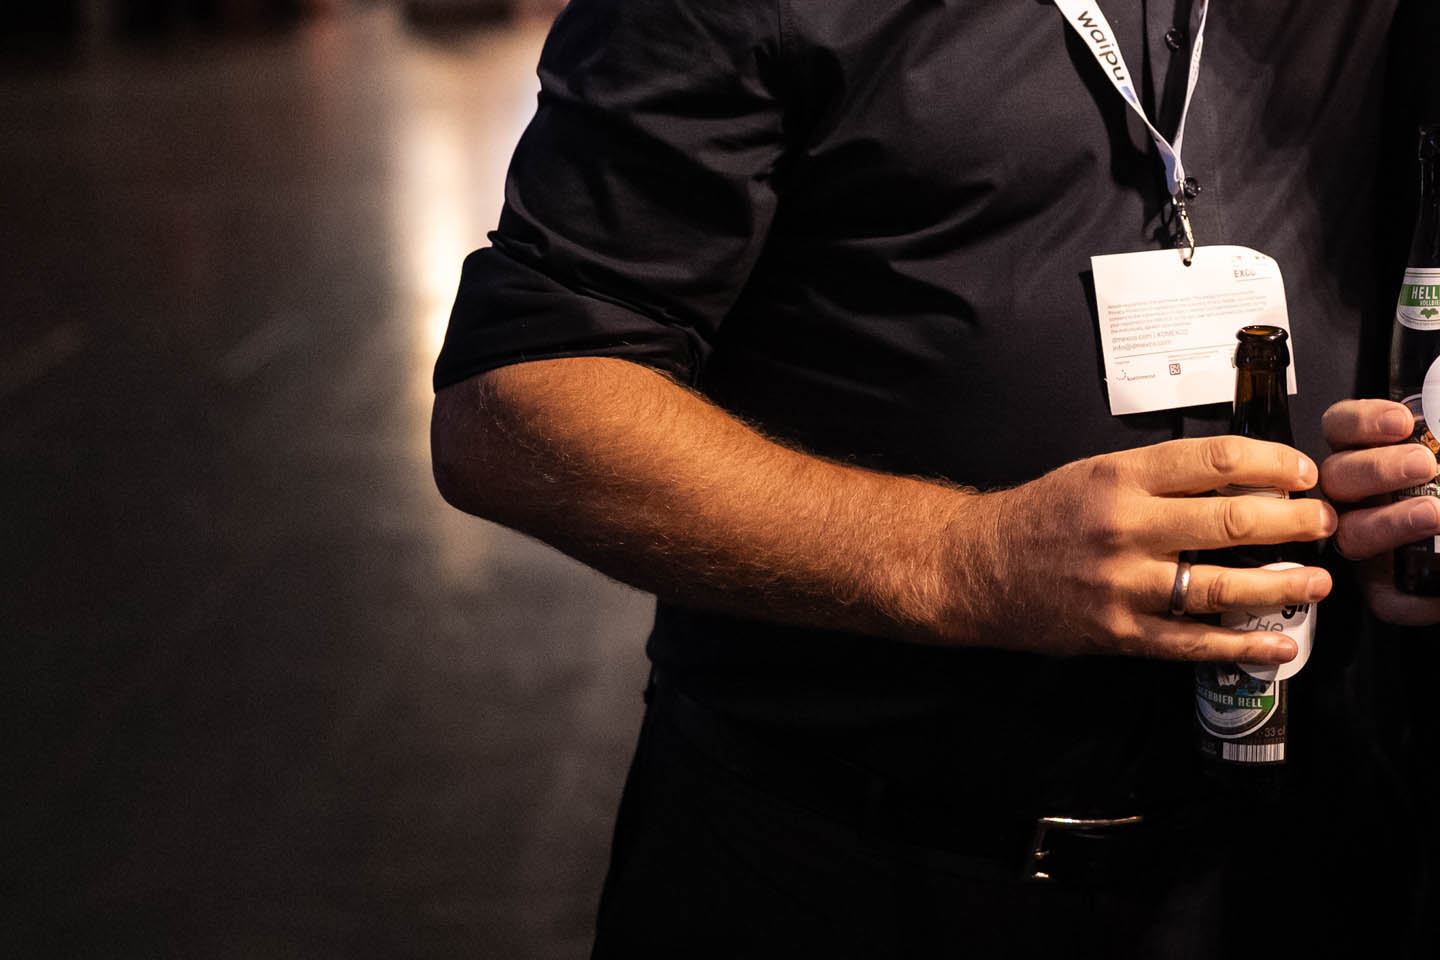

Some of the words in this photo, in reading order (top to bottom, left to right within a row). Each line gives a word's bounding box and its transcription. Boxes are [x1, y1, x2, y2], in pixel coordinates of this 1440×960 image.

[1076, 10, 1126, 83] waipu
[1238, 696, 1263, 708] HELL
[1264, 727, 1276, 738] 33
